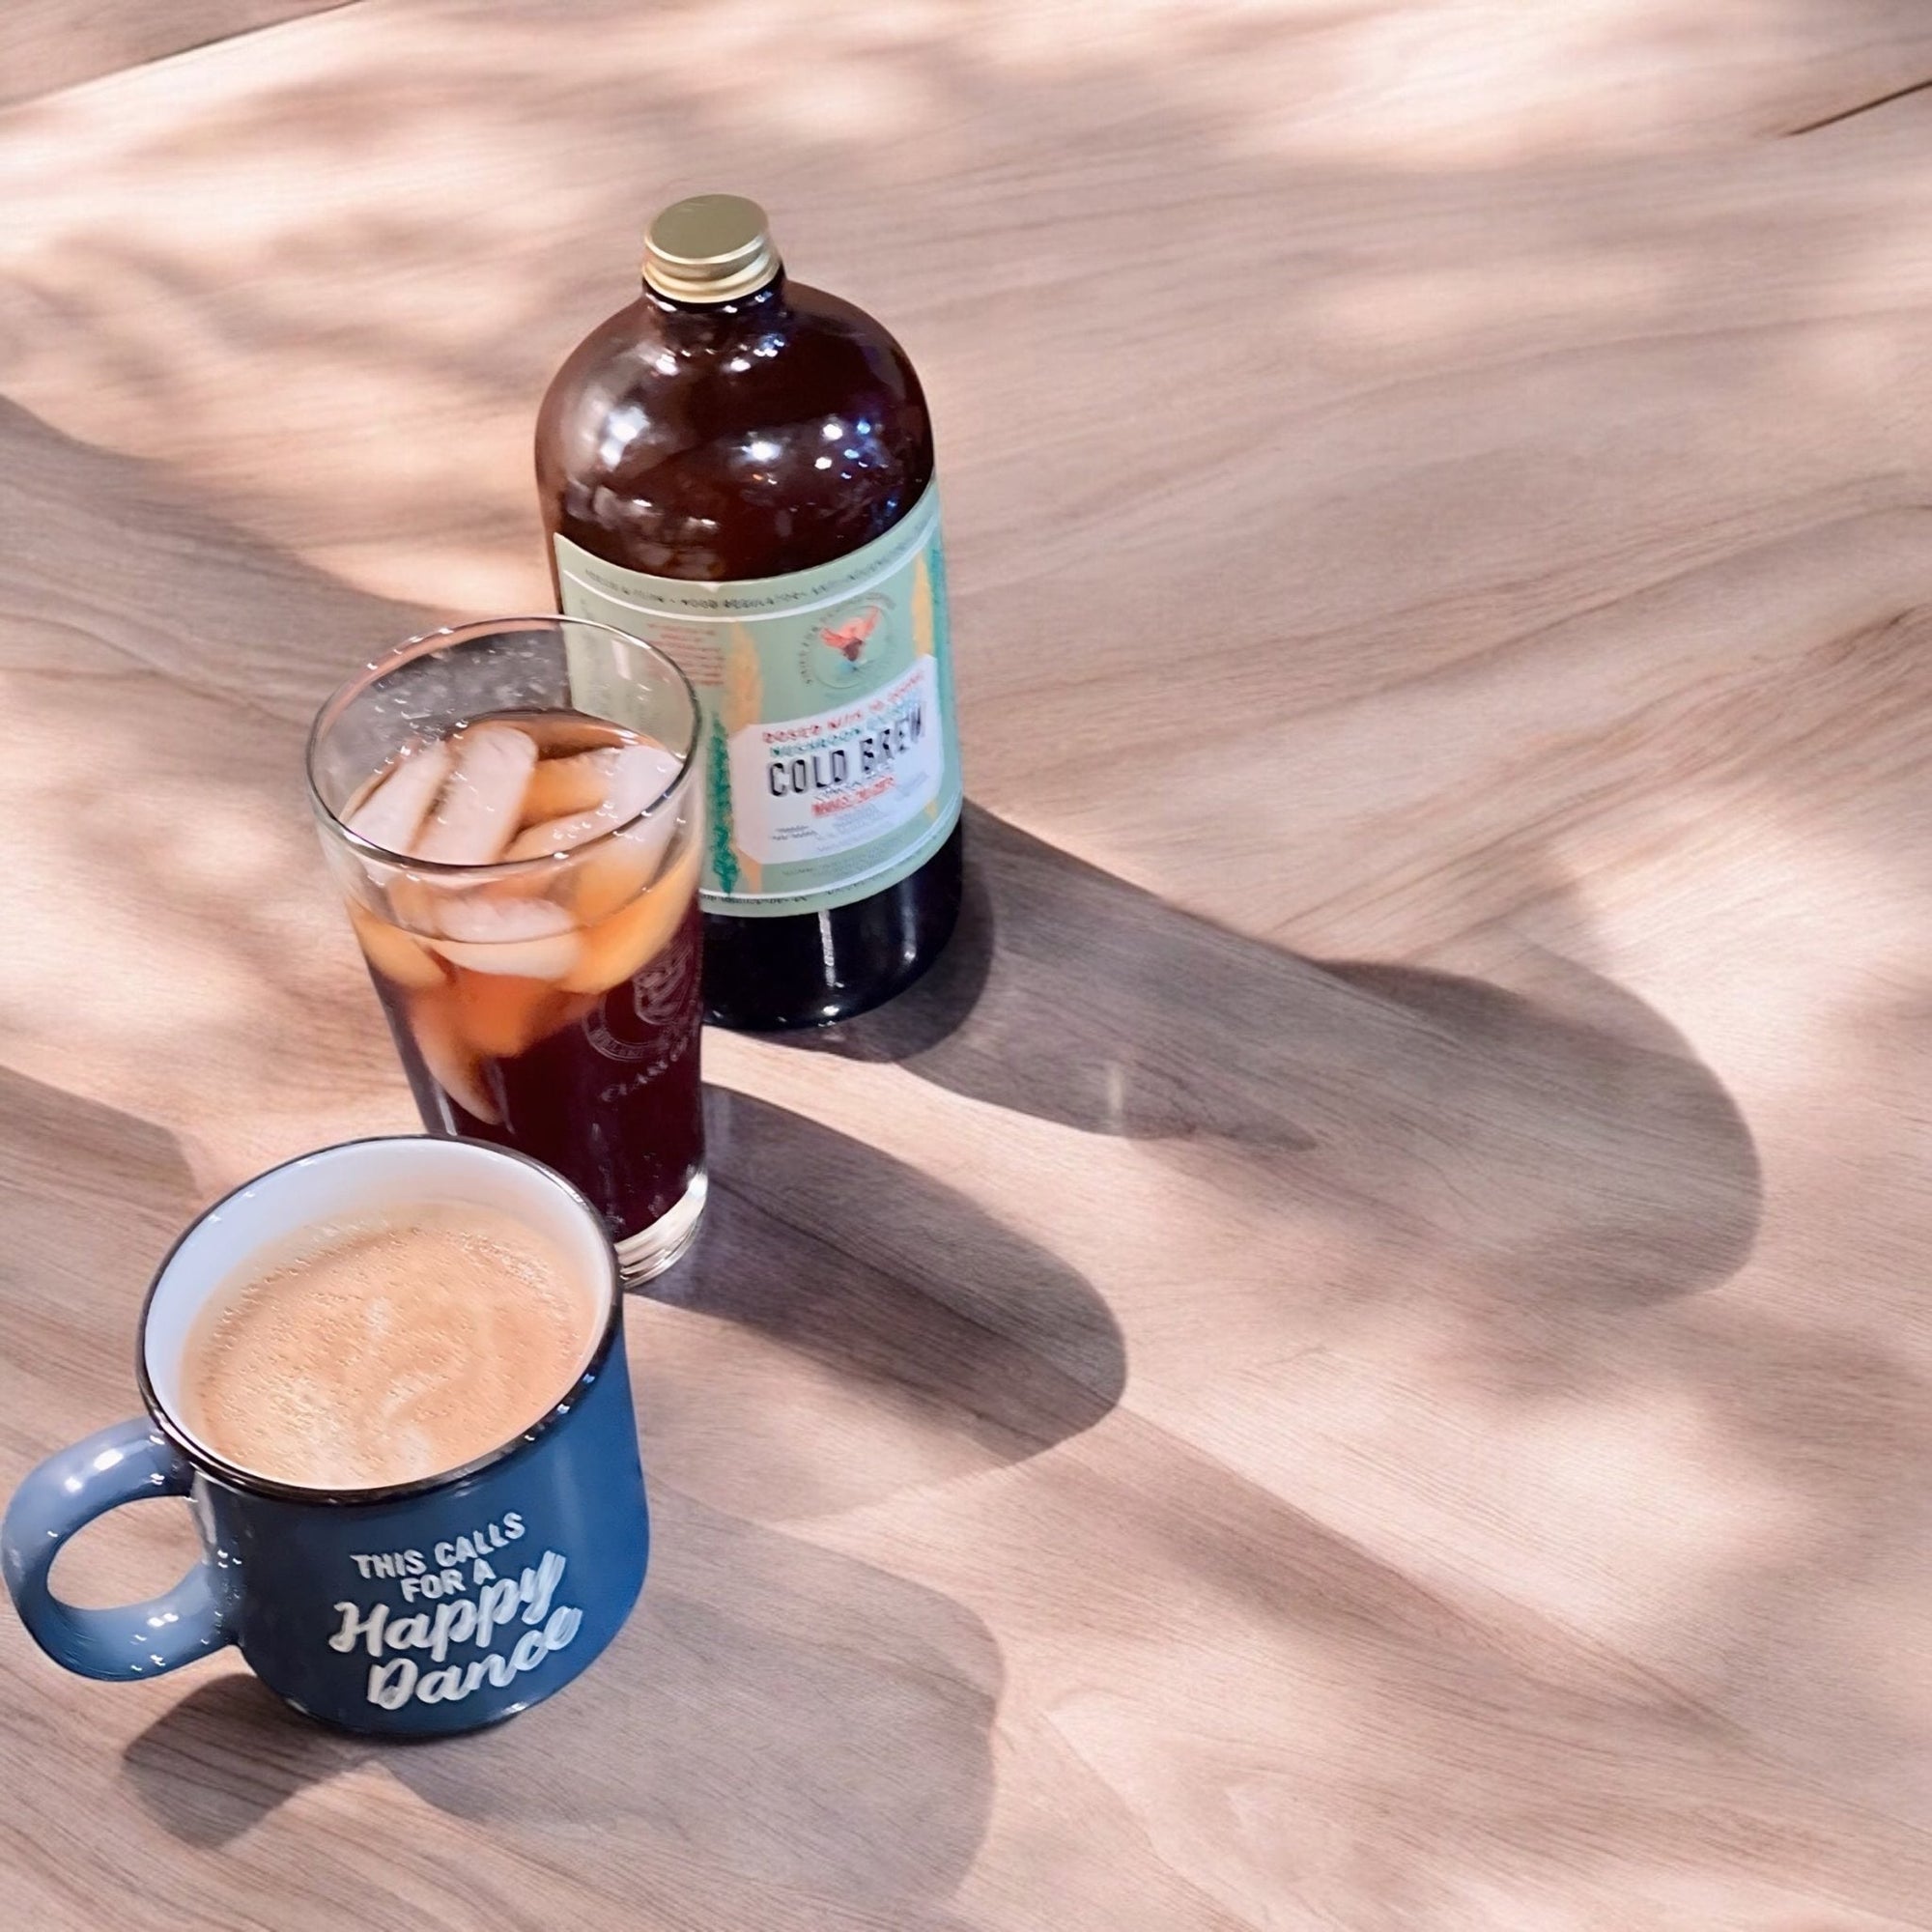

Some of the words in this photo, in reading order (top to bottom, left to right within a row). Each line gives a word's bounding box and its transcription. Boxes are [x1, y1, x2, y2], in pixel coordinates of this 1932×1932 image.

[768, 749, 847, 797] COLD
[859, 702, 926, 774] BREW
[350, 1549, 427, 1579] THIS
[435, 1512, 526, 1567] CALLS
[400, 1569, 466, 1603] FOR
[473, 1558, 497, 1585] A
[328, 1550, 567, 1662] Happy
[367, 1605, 583, 1710] Dance
